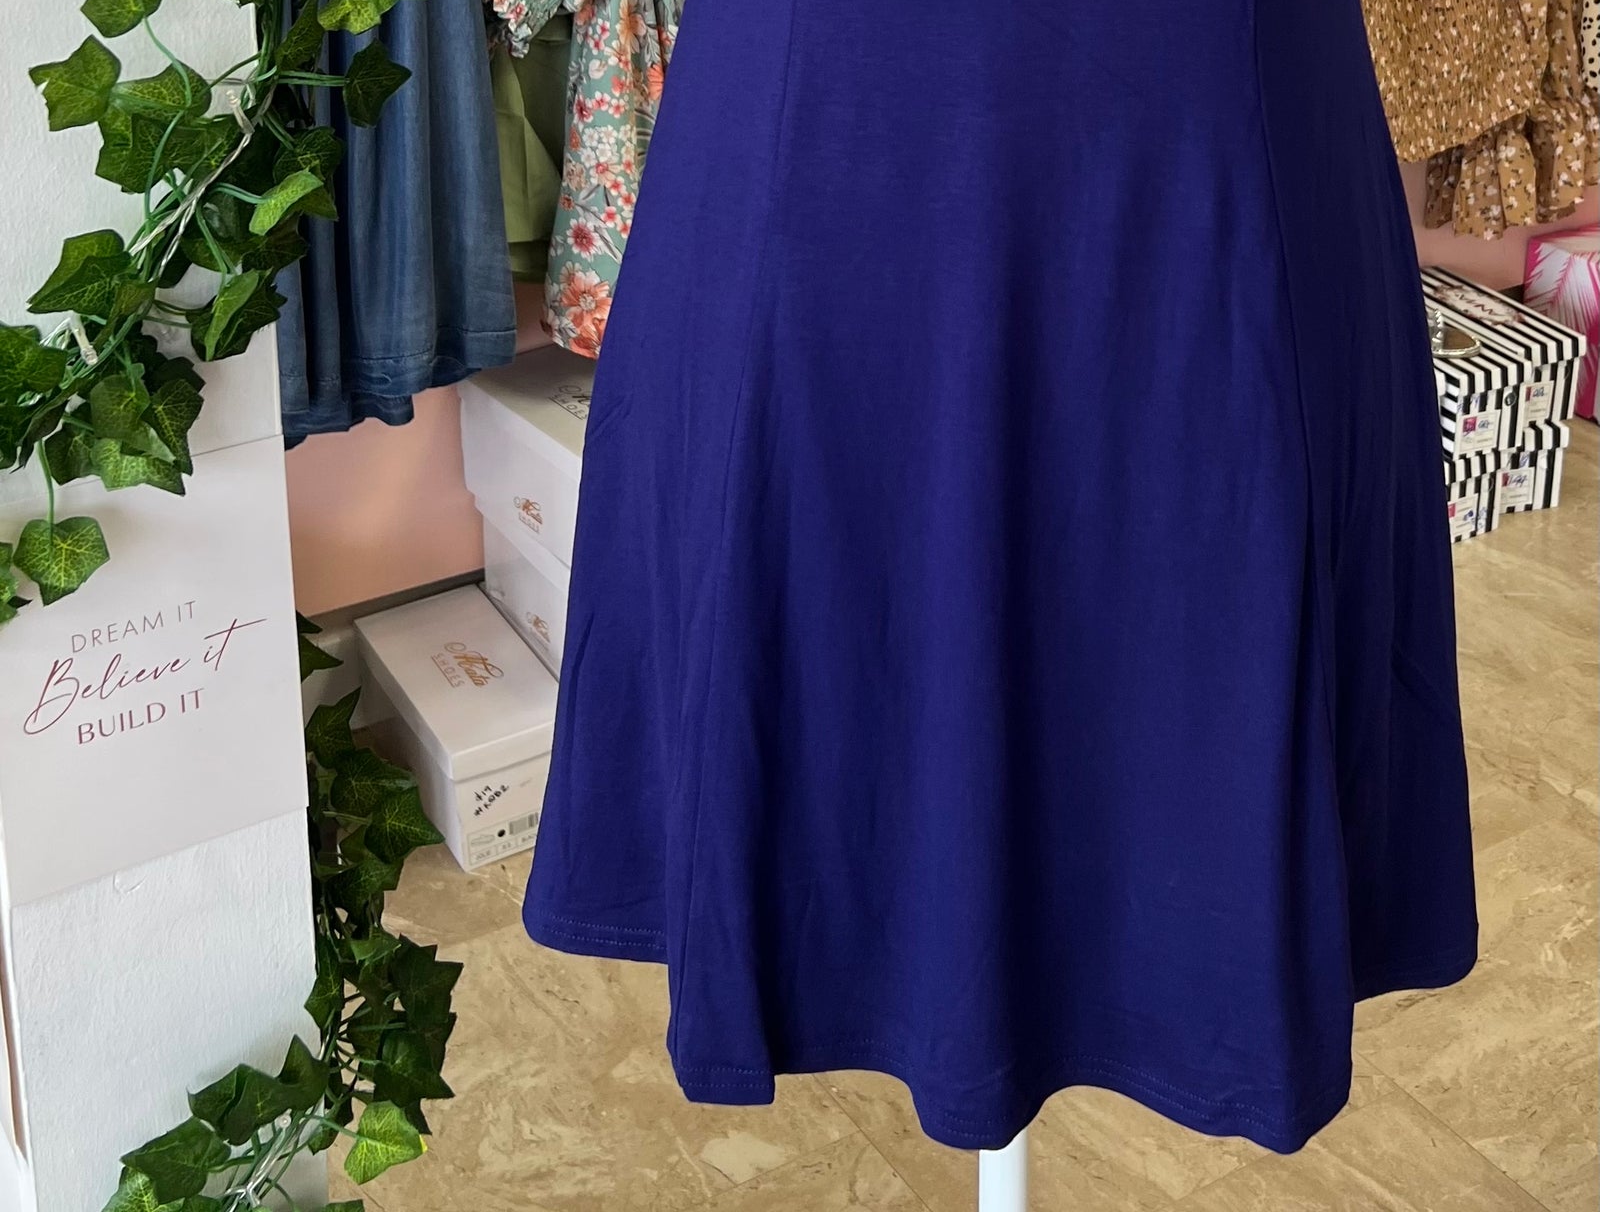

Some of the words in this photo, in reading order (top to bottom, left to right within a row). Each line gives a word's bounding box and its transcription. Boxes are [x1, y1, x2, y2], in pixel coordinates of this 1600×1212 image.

[71, 611, 164, 654] DREAM
[177, 600, 196, 623] IT
[23, 653, 191, 735] Believe
[203, 618, 268, 671] it
[77, 702, 166, 744] BUILD
[180, 688, 205, 713] IT
